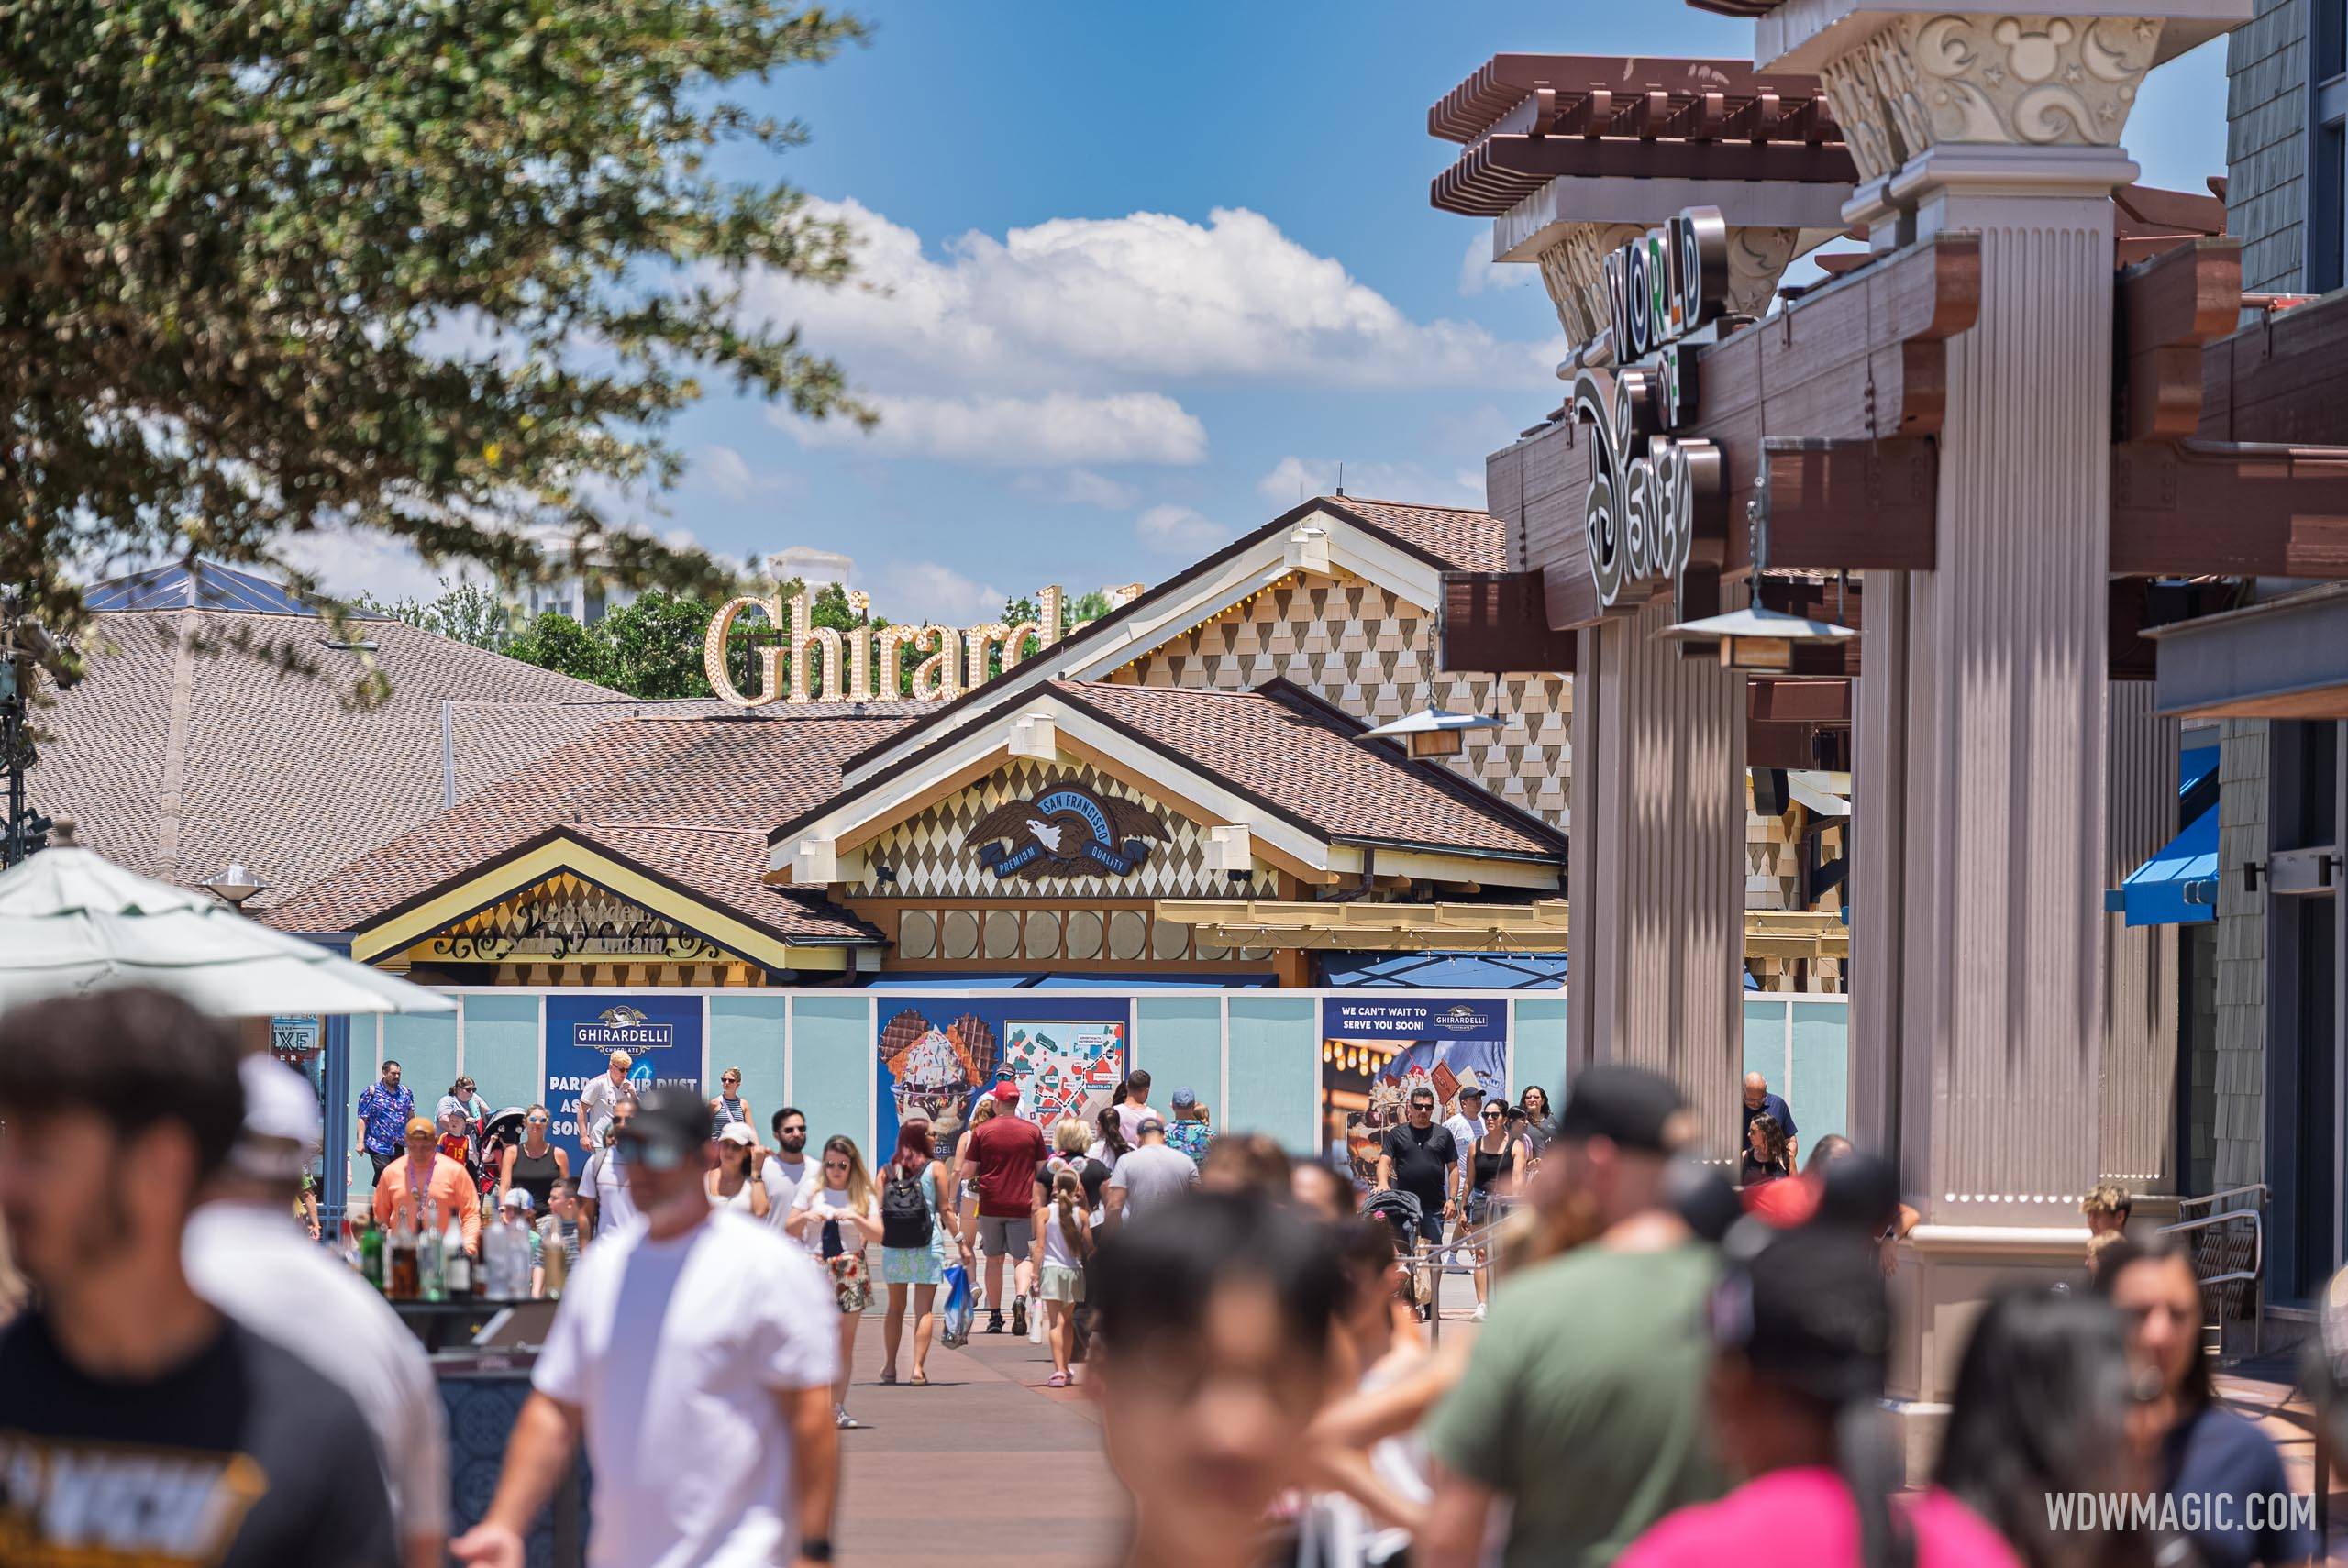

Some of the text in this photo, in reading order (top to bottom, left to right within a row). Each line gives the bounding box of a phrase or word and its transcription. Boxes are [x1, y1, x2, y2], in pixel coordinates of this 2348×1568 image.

[1603, 207, 1713, 364] WORLD
[1656, 347, 1682, 431] OF
[704, 584, 1145, 707] Ghirard
[1044, 795, 1108, 840] SAN FRANCISCO
[999, 846, 1036, 875] PREMIUM
[1091, 845, 1124, 871] QUALITY
[1342, 1007, 1427, 1017] WE CAN'T WAIT TO
[1436, 1016, 1486, 1024] GHIRARDELLI
[579, 1029, 668, 1043] GHIRARDELLI
[1343, 1021, 1424, 1031] SERVE YOU SOON!
[274, 1032, 309, 1052] XE
[550, 1077, 590, 1090] PARD
[630, 1077, 652, 1093] UR
[454, 1147, 464, 1160] 19
